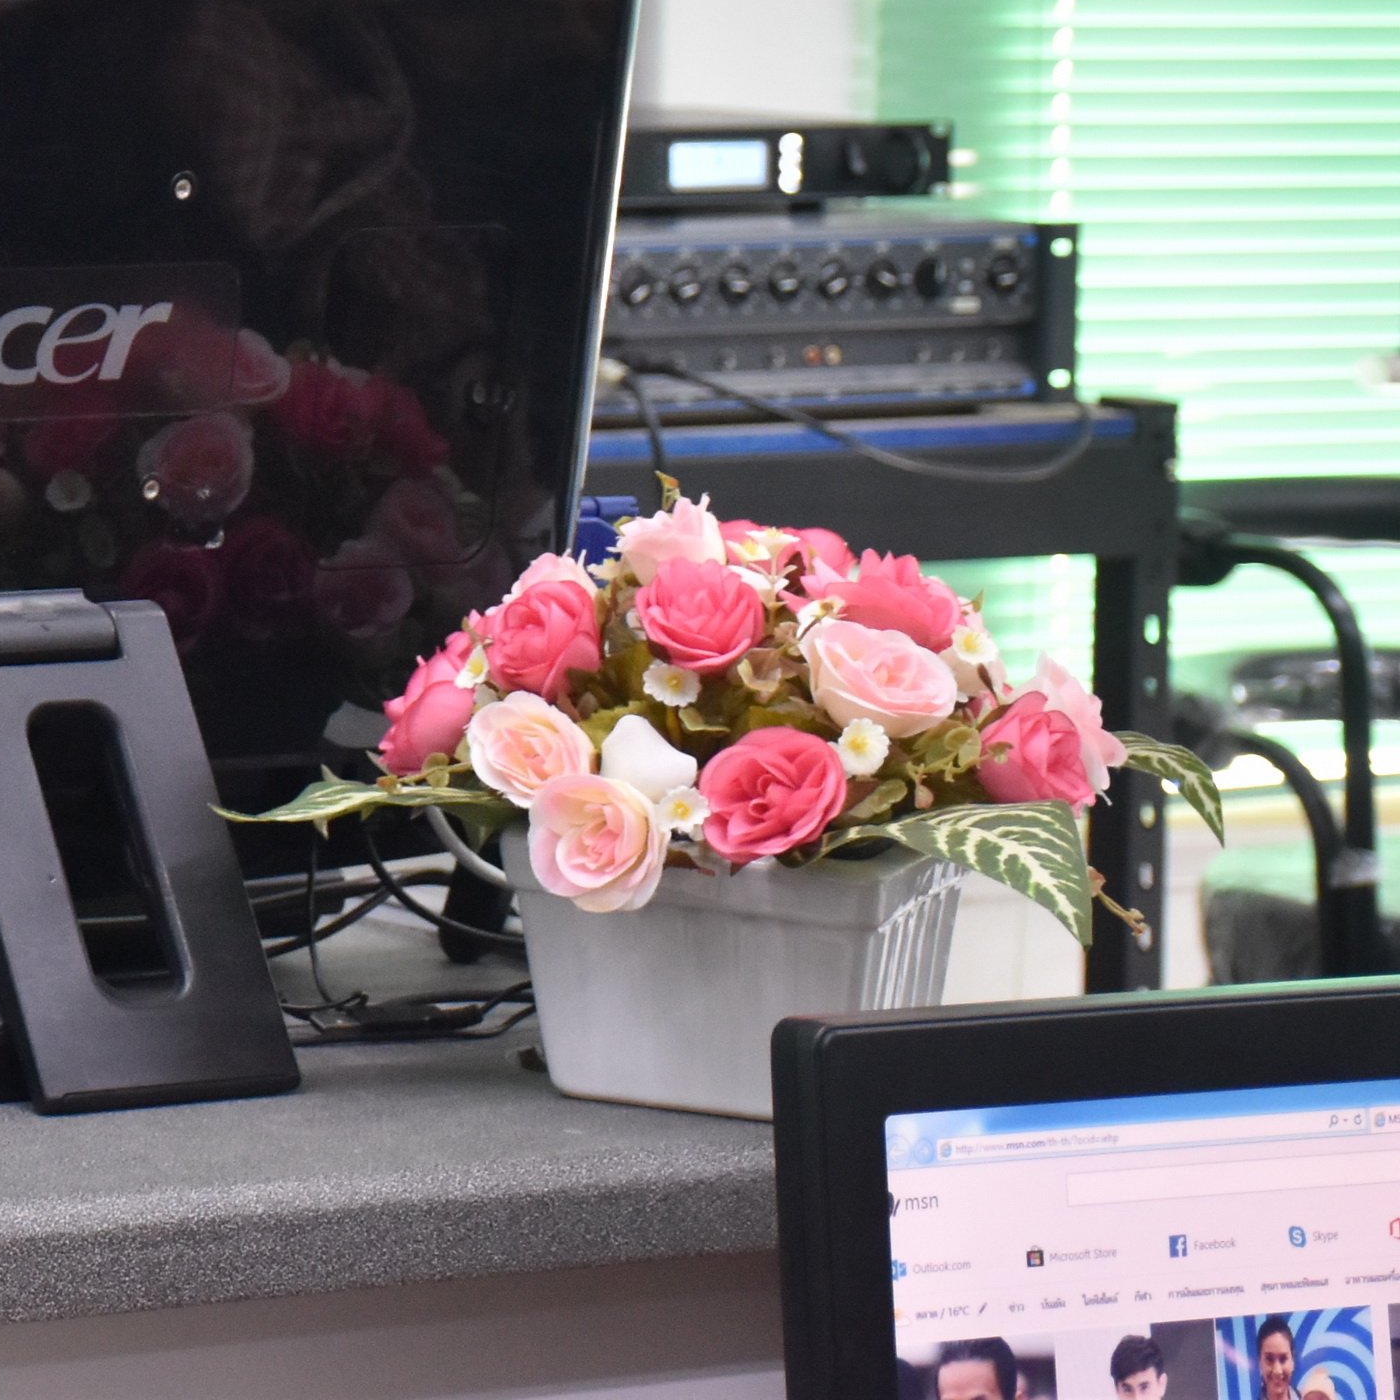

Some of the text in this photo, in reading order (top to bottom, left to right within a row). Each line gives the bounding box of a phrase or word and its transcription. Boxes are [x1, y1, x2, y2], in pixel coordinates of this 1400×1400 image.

[905, 1194, 939, 1212] msn
[1194, 1238, 1236, 1250] Facebook
[1312, 1231, 1339, 1244] Skype
[1050, 1248, 1118, 1262] Microsoft Store
[913, 1260, 971, 1275] Outlook.com
